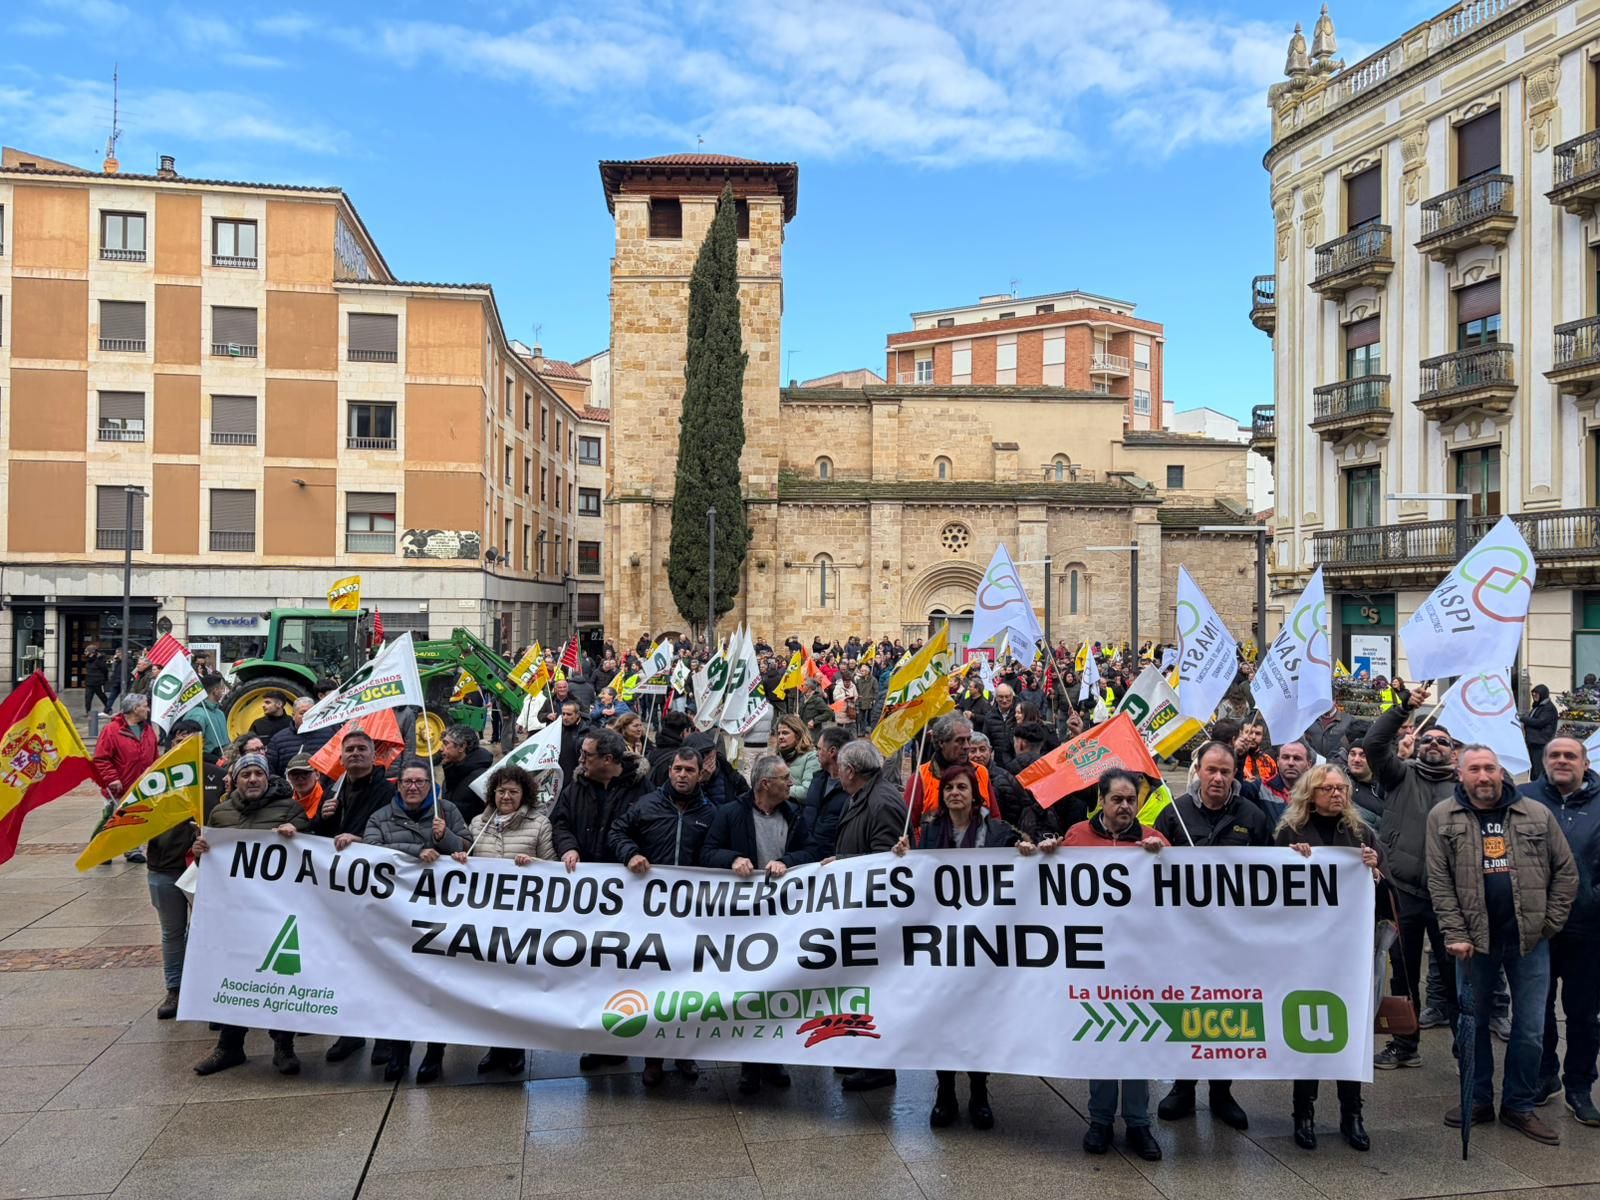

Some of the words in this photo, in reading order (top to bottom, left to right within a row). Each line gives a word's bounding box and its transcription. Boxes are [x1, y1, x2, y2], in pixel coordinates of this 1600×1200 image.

[181, 684, 203, 702] UCCL
[361, 683, 401, 703] UCCL
[1151, 707, 1176, 731] UCCL
[1073, 746, 1112, 768] UPA
[230, 841, 288, 881] NO
[295, 849, 318, 886] A
[329, 854, 396, 900] LOS
[409, 868, 624, 916] ACUERDOS
[643, 866, 915, 918] COMERCIALES
[934, 864, 1016, 911] QUE
[1039, 862, 1132, 906] NOS
[1153, 863, 1339, 907] HUNDEN
[411, 919, 671, 971] ZAMORA
[693, 933, 779, 973] NO
[797, 927, 879, 970] SE
[902, 925, 1106, 970] RINDE
[220, 978, 285, 995] Asociación
[288, 985, 334, 1000] Agraria
[1069, 985, 1090, 1000] La
[1097, 985, 1155, 1000] Unión
[1161, 985, 1185, 1001] de
[1191, 985, 1263, 1001] Zamora
[213, 991, 260, 1008] Jóvenes
[263, 997, 339, 1015] Agricultores
[653, 990, 729, 1023] UPA
[733, 986, 870, 1020] COAG
[656, 1025, 784, 1039] ALIANZA
[1181, 1007, 1256, 1039] UCCL
[1191, 1044, 1267, 1060] Zamora
